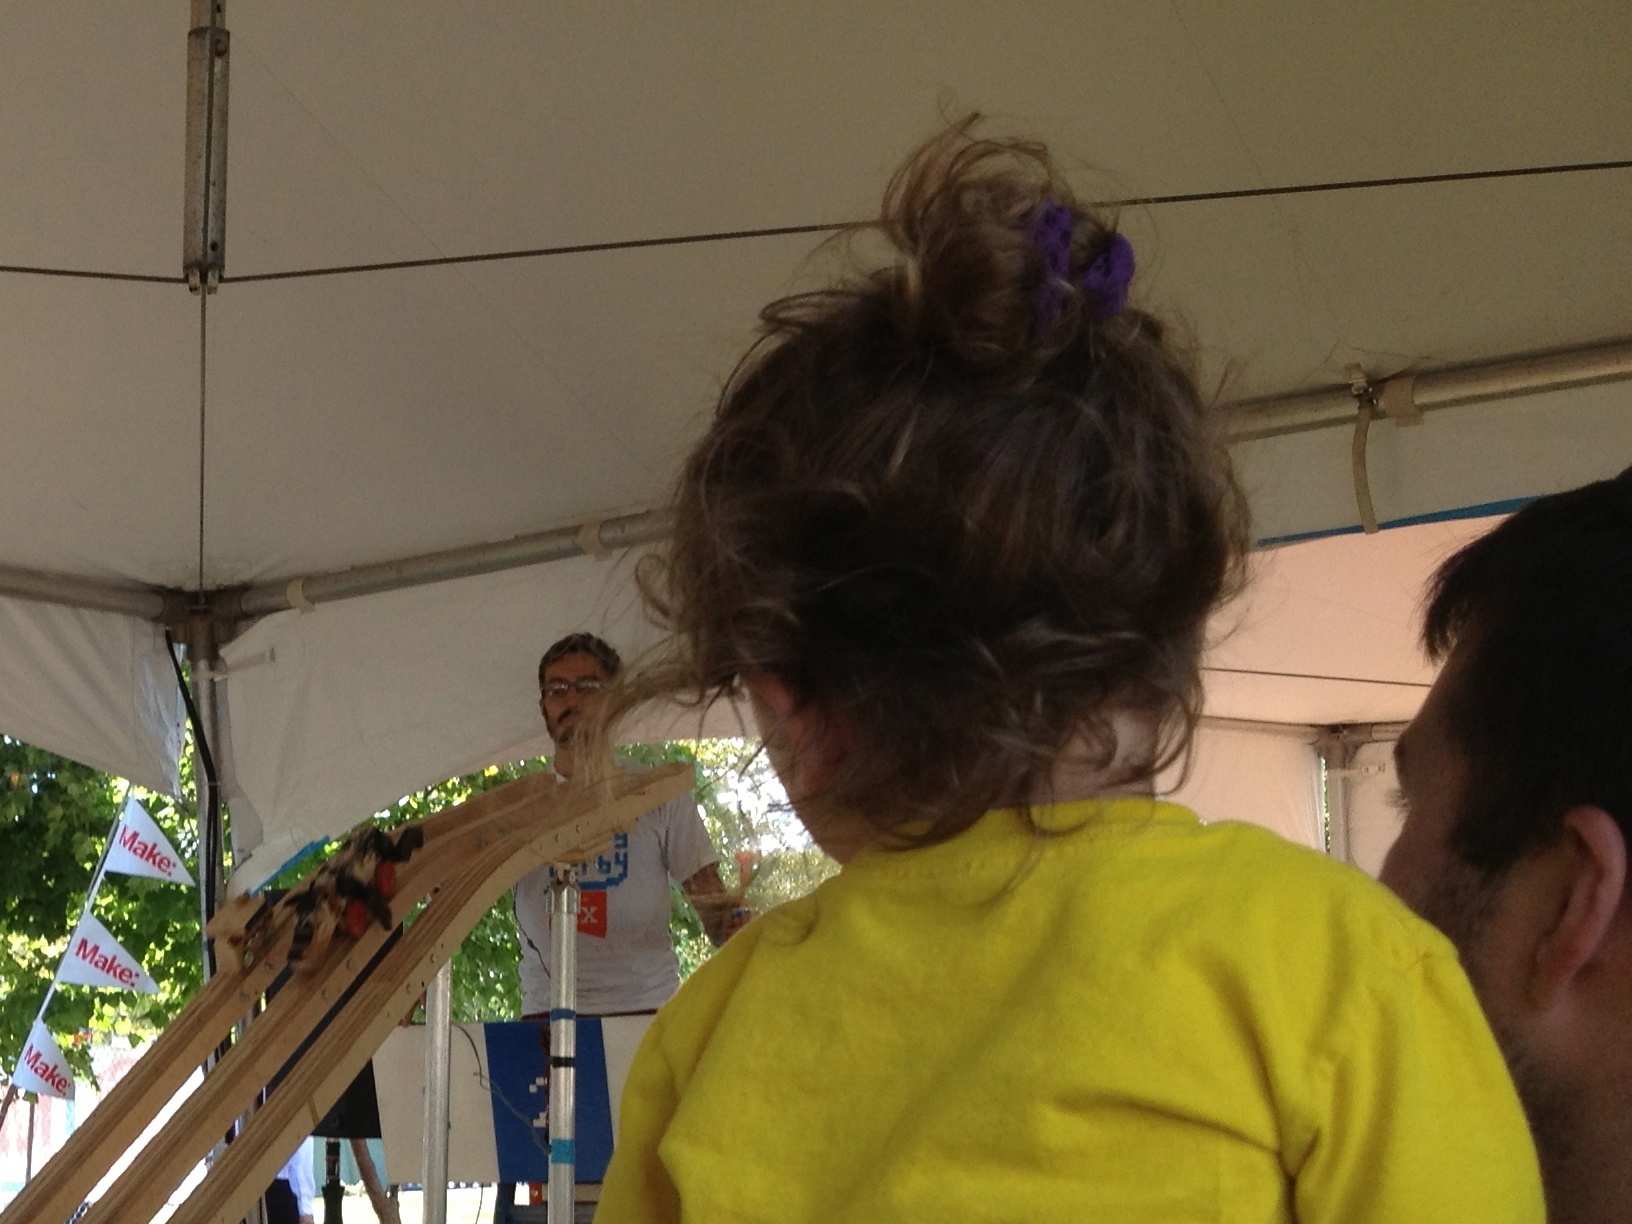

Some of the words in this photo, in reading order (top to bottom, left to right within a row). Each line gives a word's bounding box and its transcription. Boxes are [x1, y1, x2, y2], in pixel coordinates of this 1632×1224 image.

[119, 824, 177, 877] Make:
[76, 937, 140, 987] Make:
[23, 1043, 71, 1097] Make:
